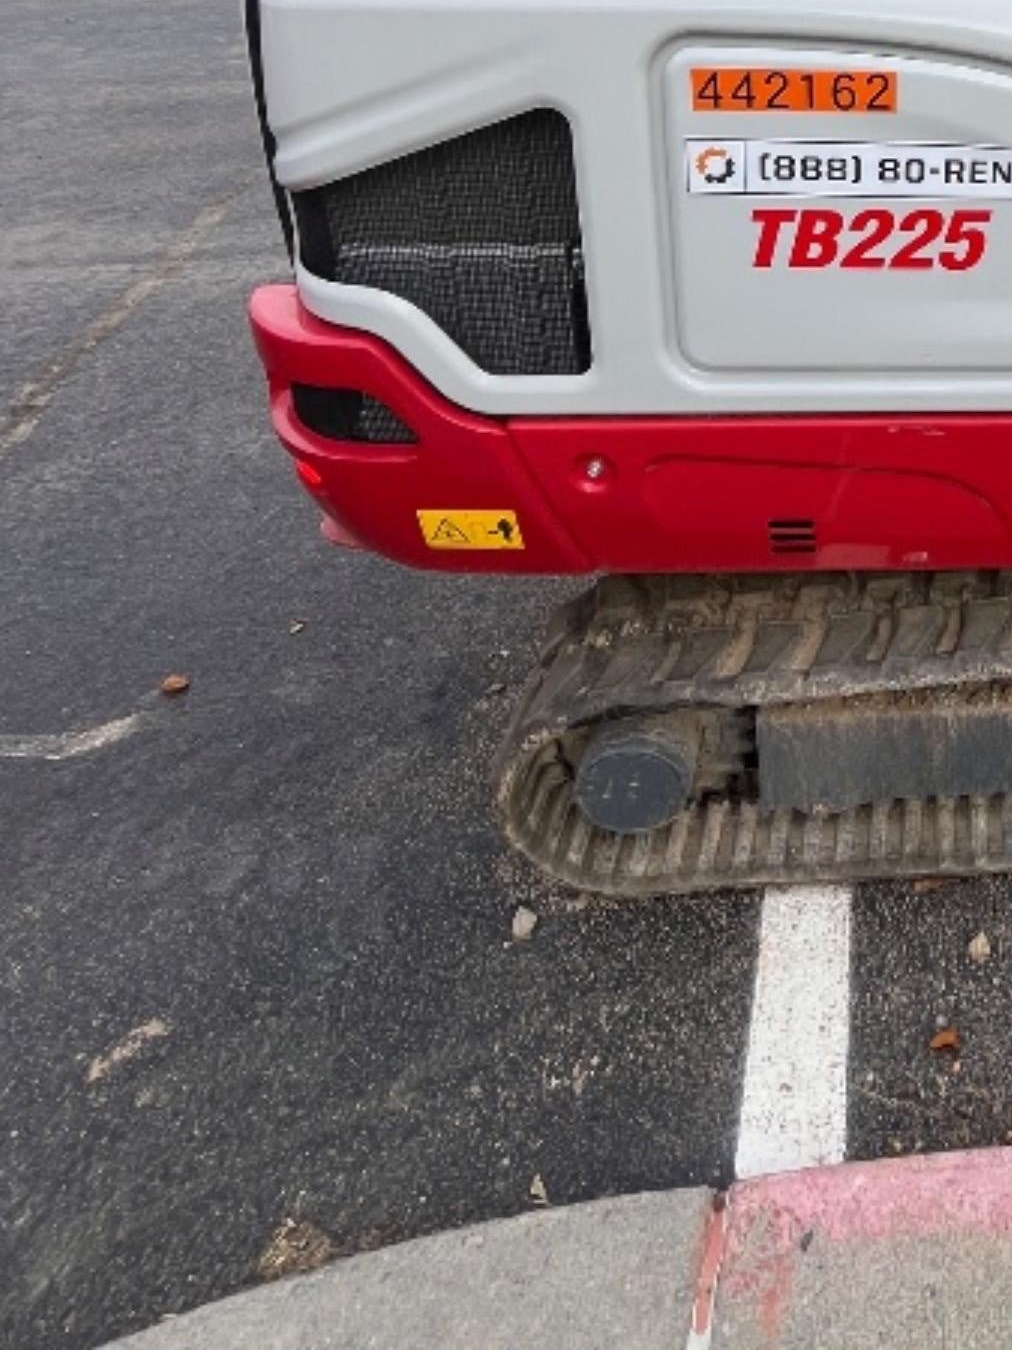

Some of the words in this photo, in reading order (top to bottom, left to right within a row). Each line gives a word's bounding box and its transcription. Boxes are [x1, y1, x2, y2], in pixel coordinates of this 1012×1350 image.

[696, 73, 891, 110] 442162
[757, 153, 864, 183] (888)
[750, 209, 992, 271] TB225
